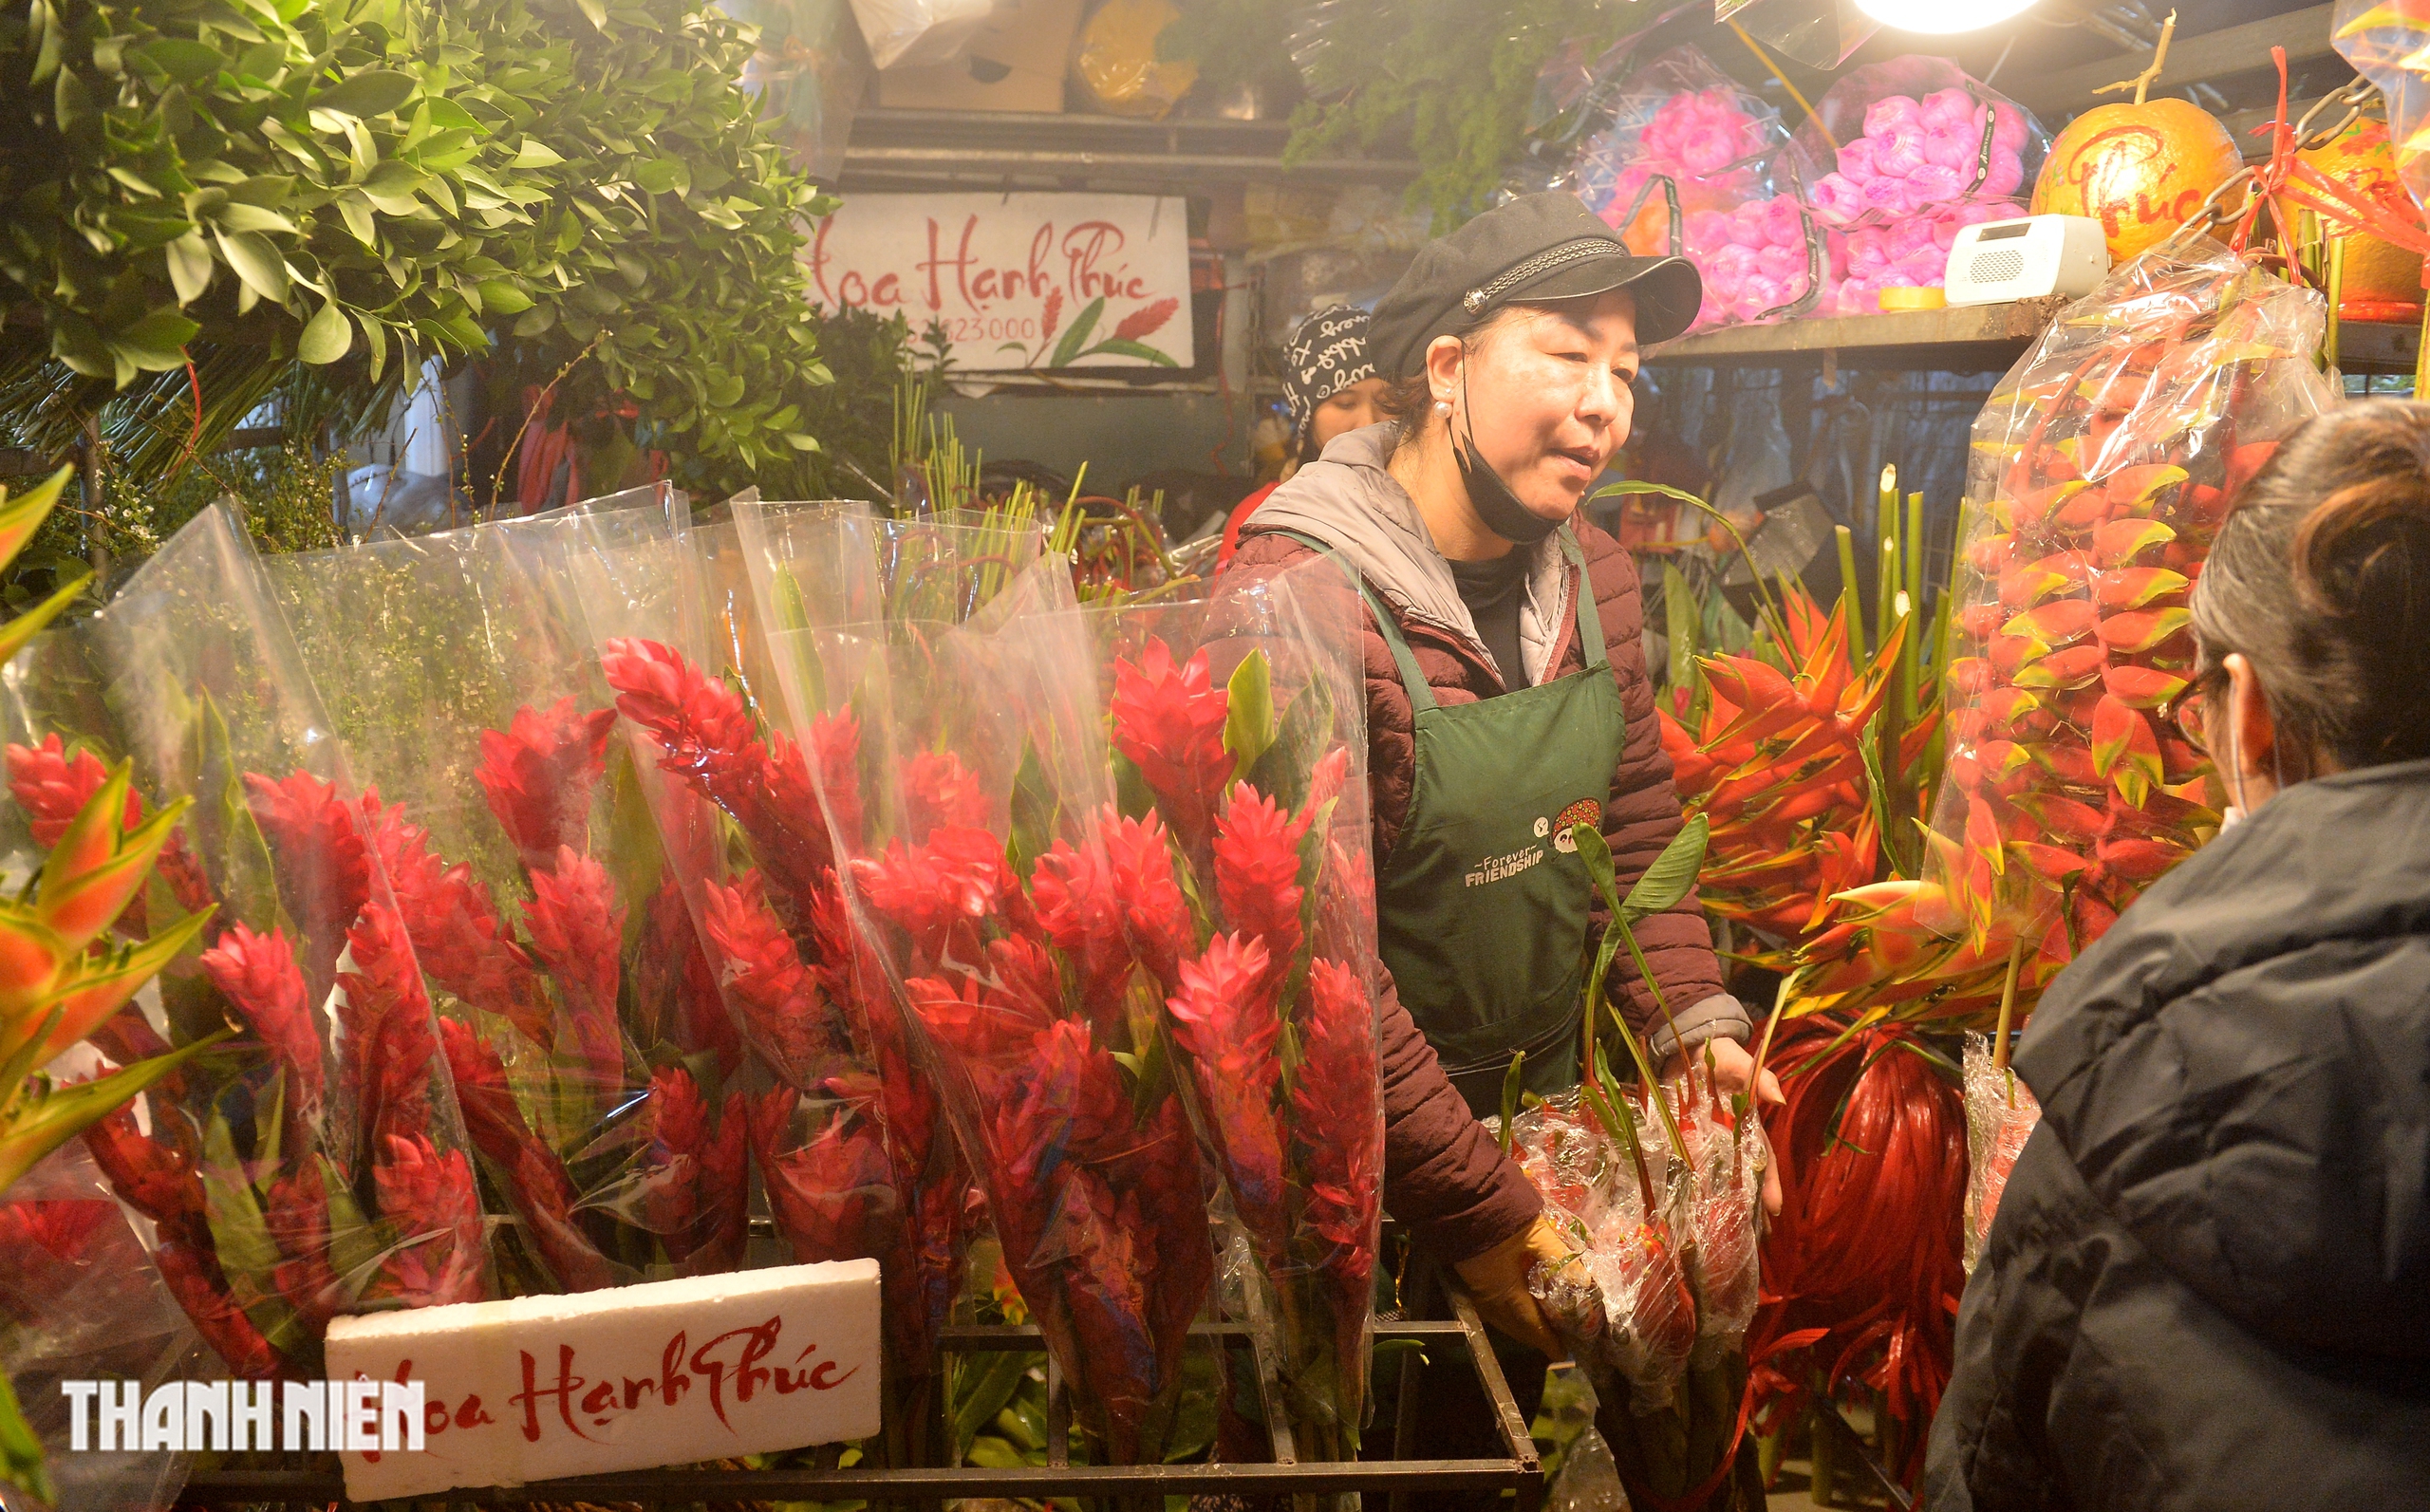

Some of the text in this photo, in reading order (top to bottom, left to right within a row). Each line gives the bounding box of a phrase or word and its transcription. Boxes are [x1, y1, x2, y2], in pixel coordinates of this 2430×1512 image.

[915, 214, 1053, 317] Hạnh
[1061, 220, 1158, 309] Phúc
[1465, 849, 1544, 887] FRIENDSHIP
[508, 1330, 690, 1445] Hạnh
[690, 1315, 862, 1437] Phúc
